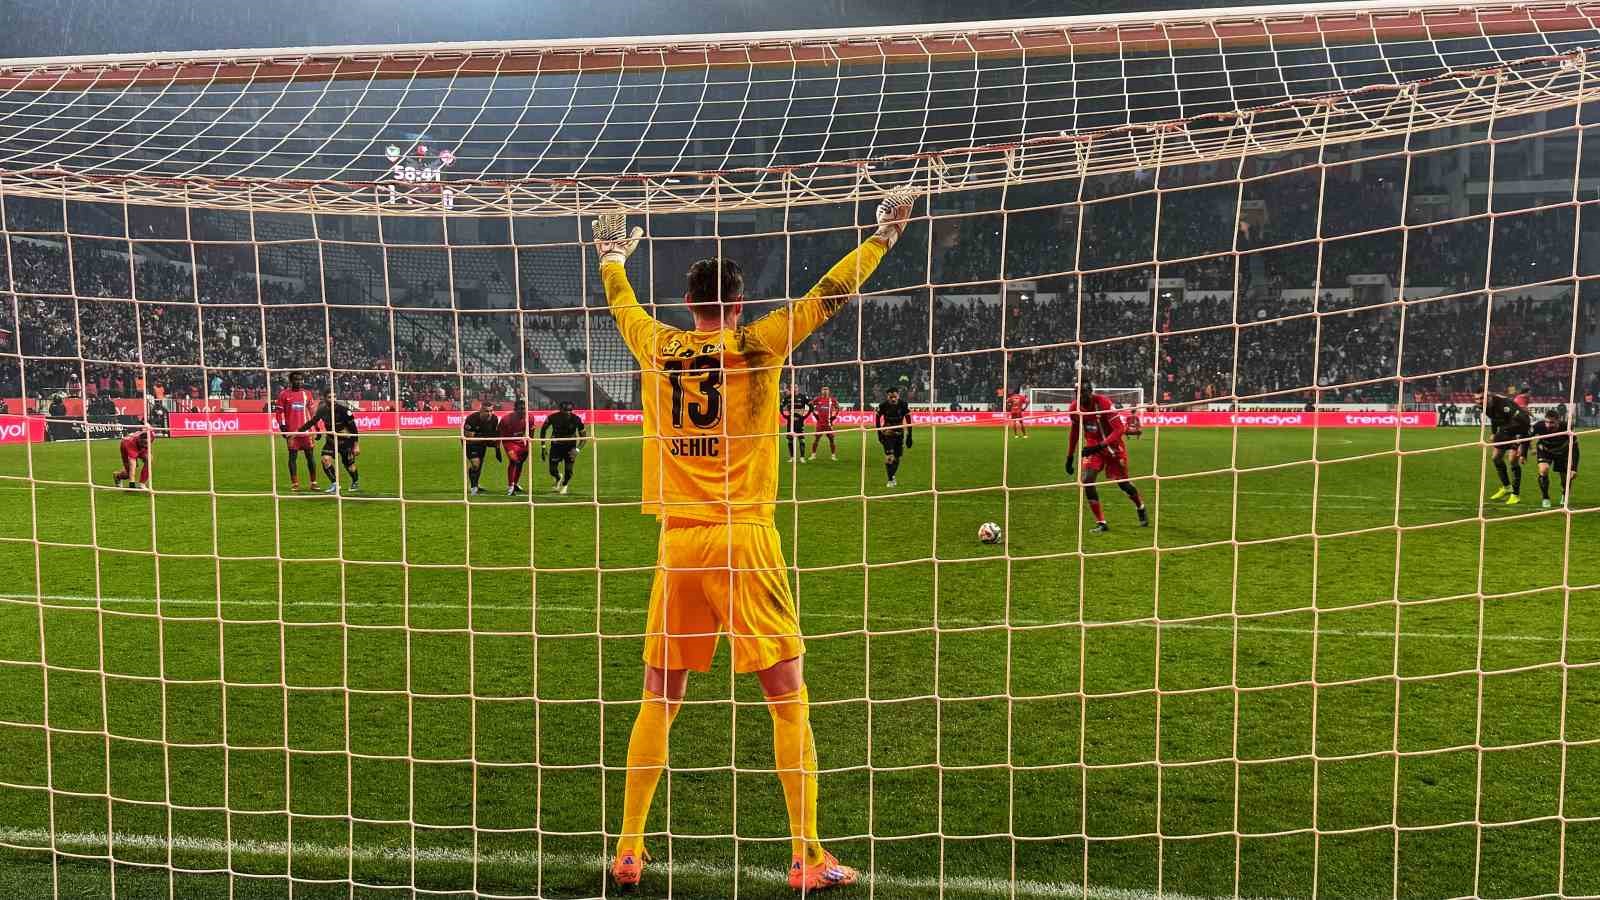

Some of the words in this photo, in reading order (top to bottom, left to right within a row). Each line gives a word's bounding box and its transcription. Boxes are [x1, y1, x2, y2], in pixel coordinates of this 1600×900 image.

[664, 357, 723, 429] 13
[400, 416, 433, 427] trendyol
[613, 412, 644, 422] tren
[912, 414, 977, 425] trendyol
[1119, 414, 1188, 425] tndyol
[1230, 415, 1302, 425] trendyol
[1345, 414, 1419, 425] trendyol
[184, 417, 239, 432] trendyol
